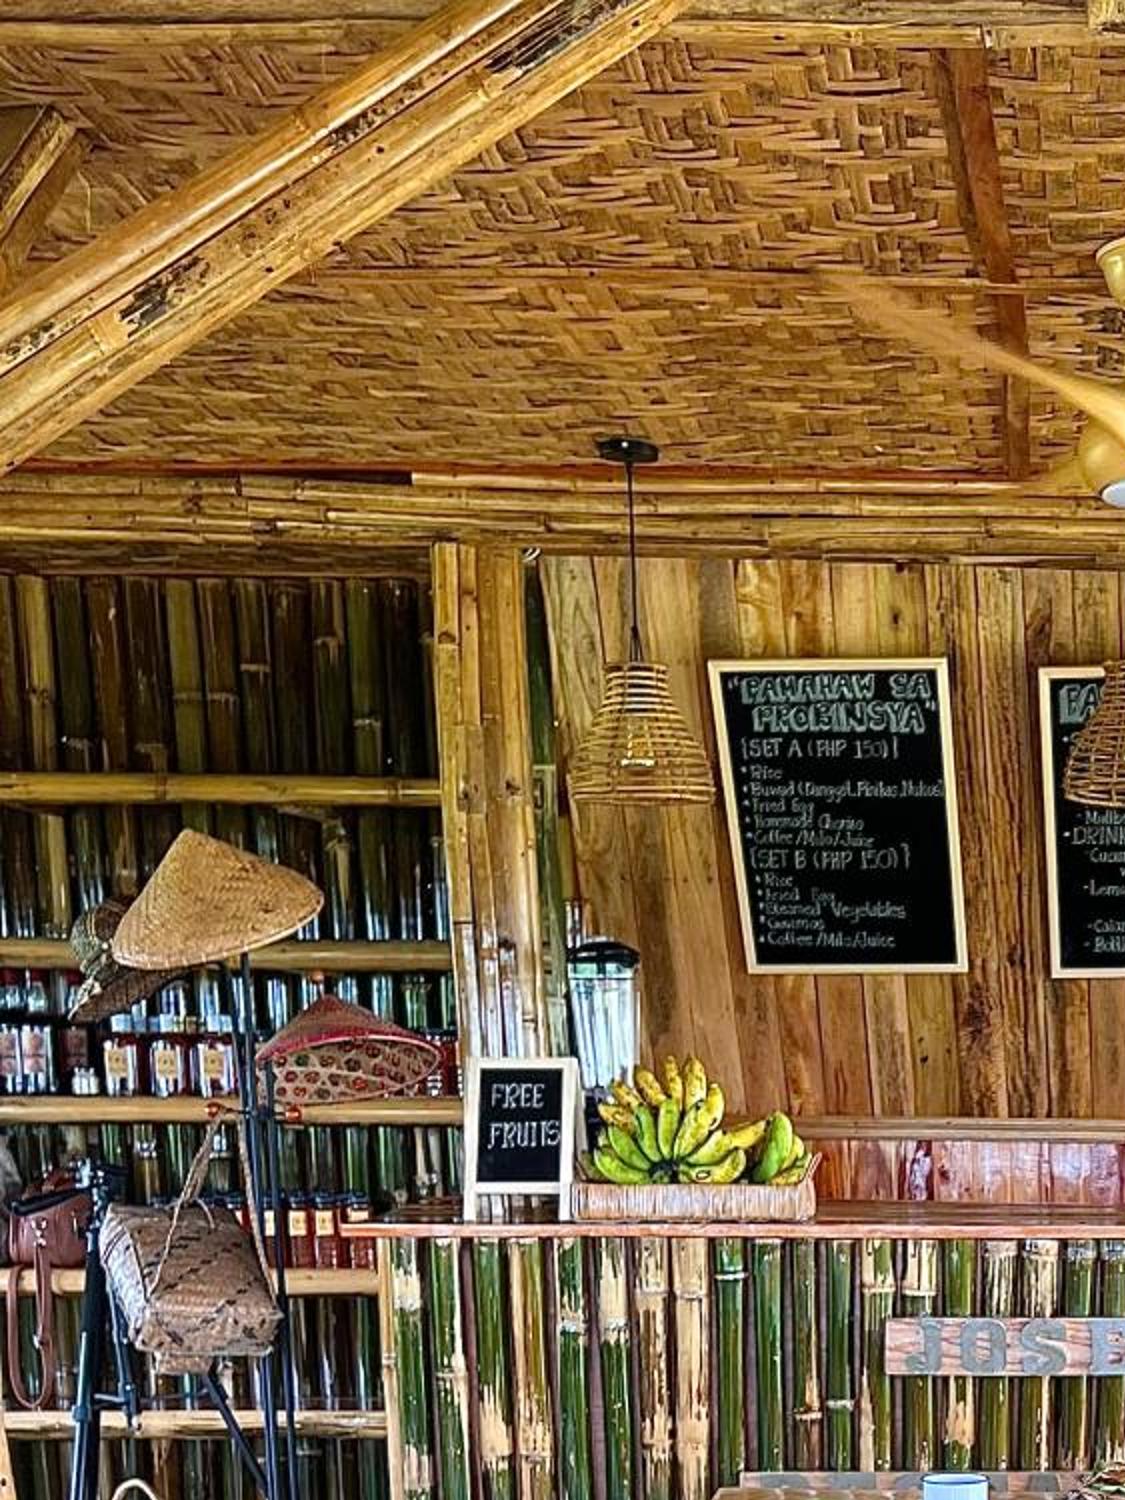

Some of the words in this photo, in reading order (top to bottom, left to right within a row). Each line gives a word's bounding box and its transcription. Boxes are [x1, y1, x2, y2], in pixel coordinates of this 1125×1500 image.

[889, 673, 931, 699] SA
[787, 740, 803, 758] A
[808, 739, 847, 758] (PHP
[750, 765, 783, 780] Rice
[794, 850, 807, 869] B
[763, 872, 793, 887] Rice
[764, 887, 800, 901] Fried
[830, 900, 907, 923] Vegetables
[491, 1083, 545, 1109] FREE
[487, 1120, 561, 1149] FRUITS
